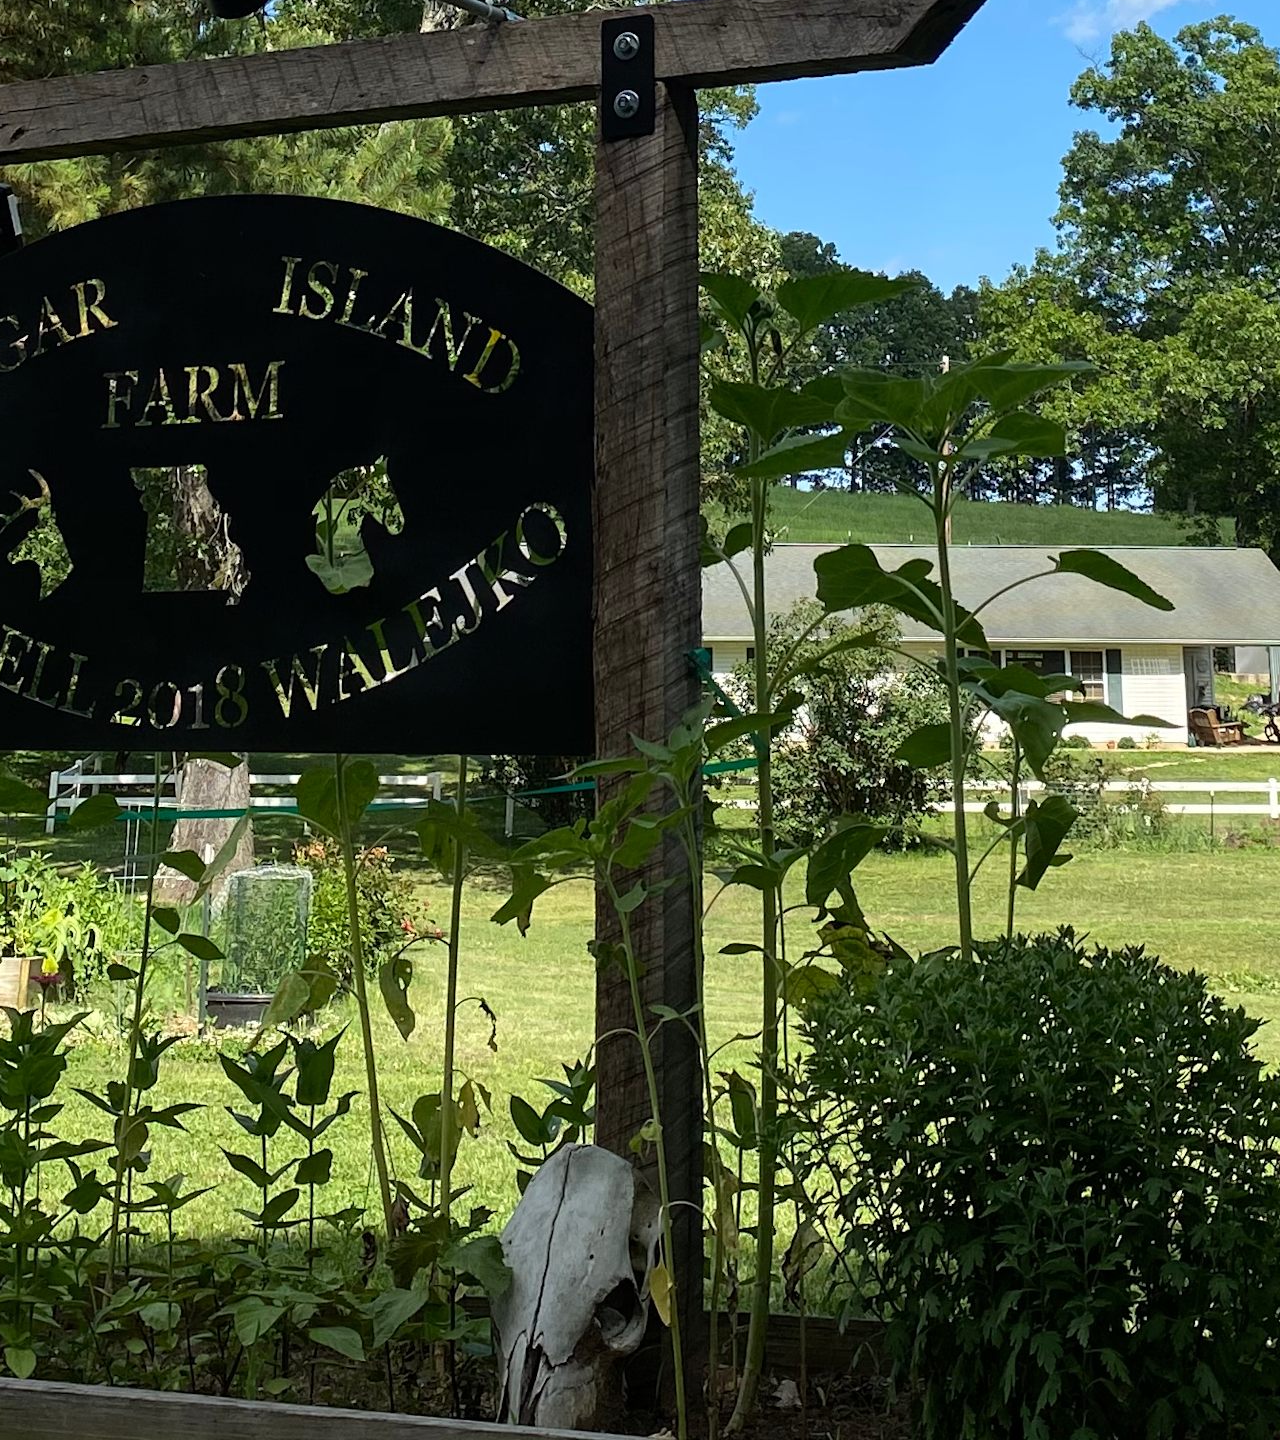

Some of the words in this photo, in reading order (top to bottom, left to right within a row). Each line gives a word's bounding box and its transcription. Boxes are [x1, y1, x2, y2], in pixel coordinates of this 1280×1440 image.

[272, 255, 523, 394] ISLAND
[100, 360, 286, 429] FARM
[109, 663, 250, 730] 2018
[260, 501, 568, 718] WALEJKO
